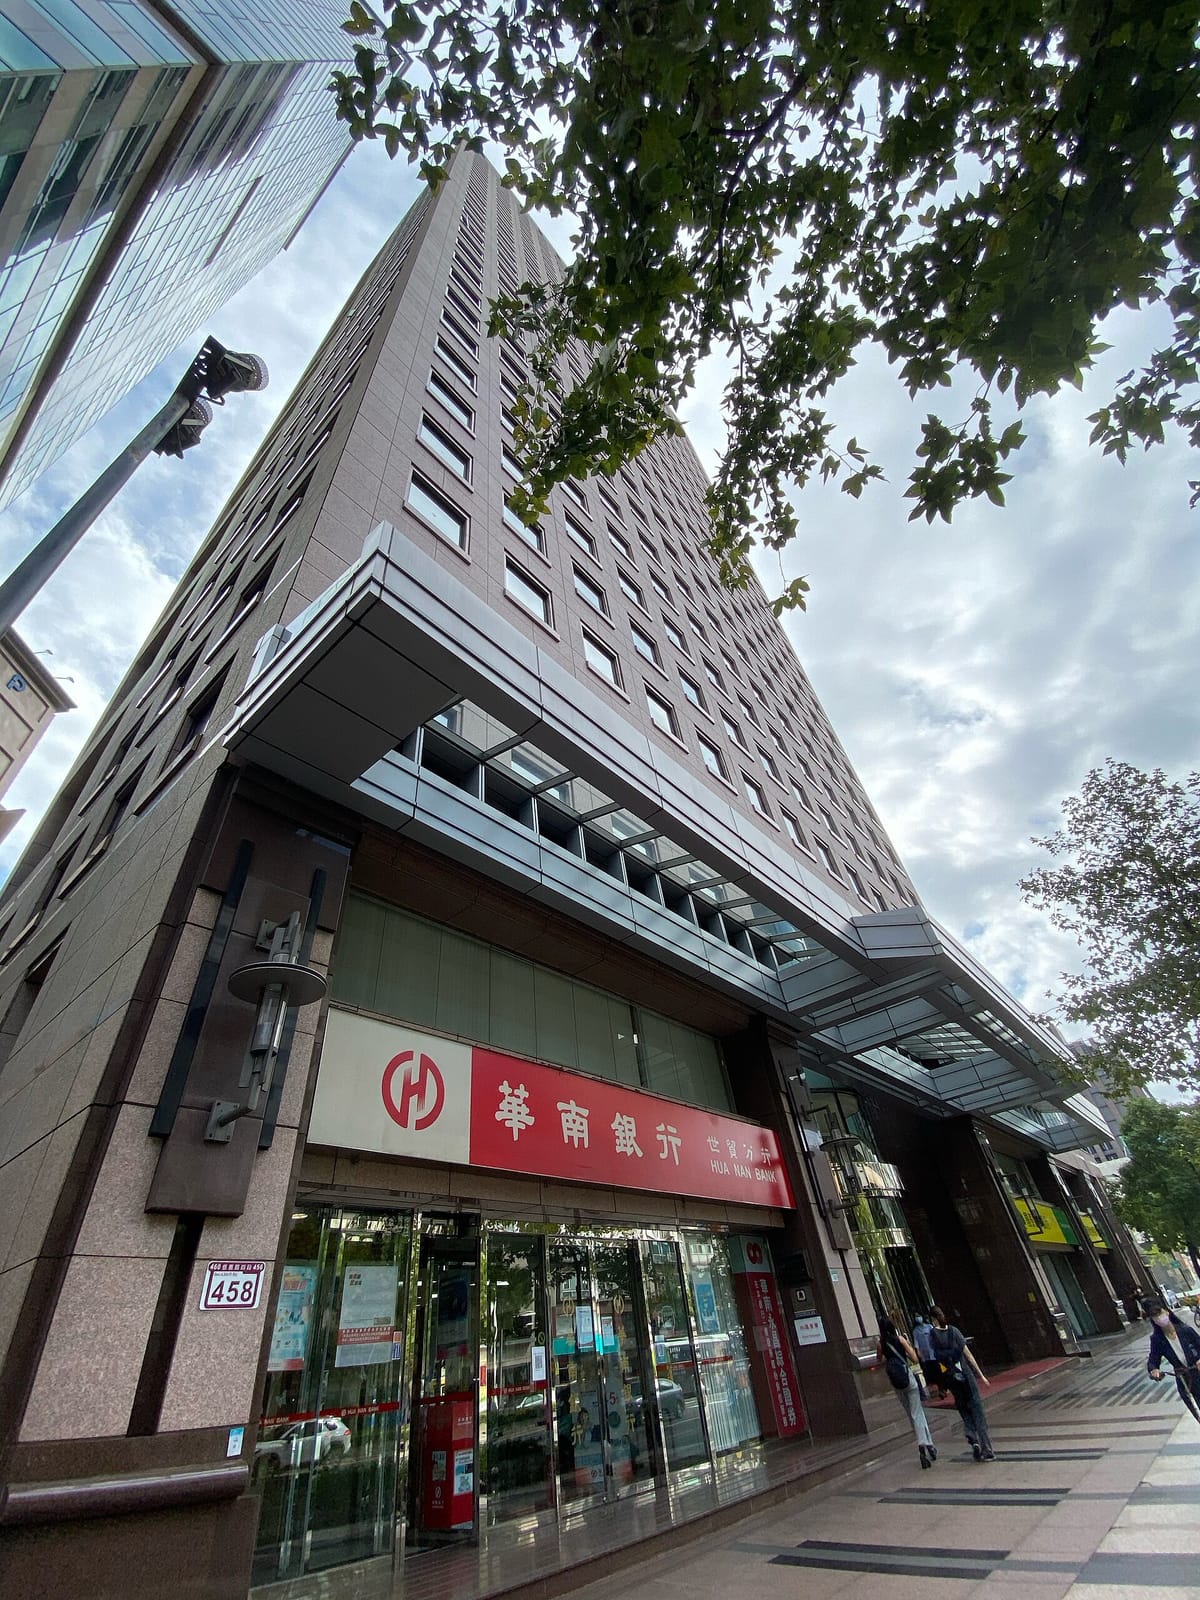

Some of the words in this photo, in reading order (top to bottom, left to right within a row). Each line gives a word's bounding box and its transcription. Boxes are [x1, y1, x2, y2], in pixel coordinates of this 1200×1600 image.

[495, 1080, 682, 1166] 華南銀行
[706, 1135, 772, 1167] 世貿分行
[710, 1159, 731, 1176] HUA
[733, 1162, 752, 1179] NAN
[754, 1167, 777, 1183] BANK
[210, 1280, 254, 1302] 458
